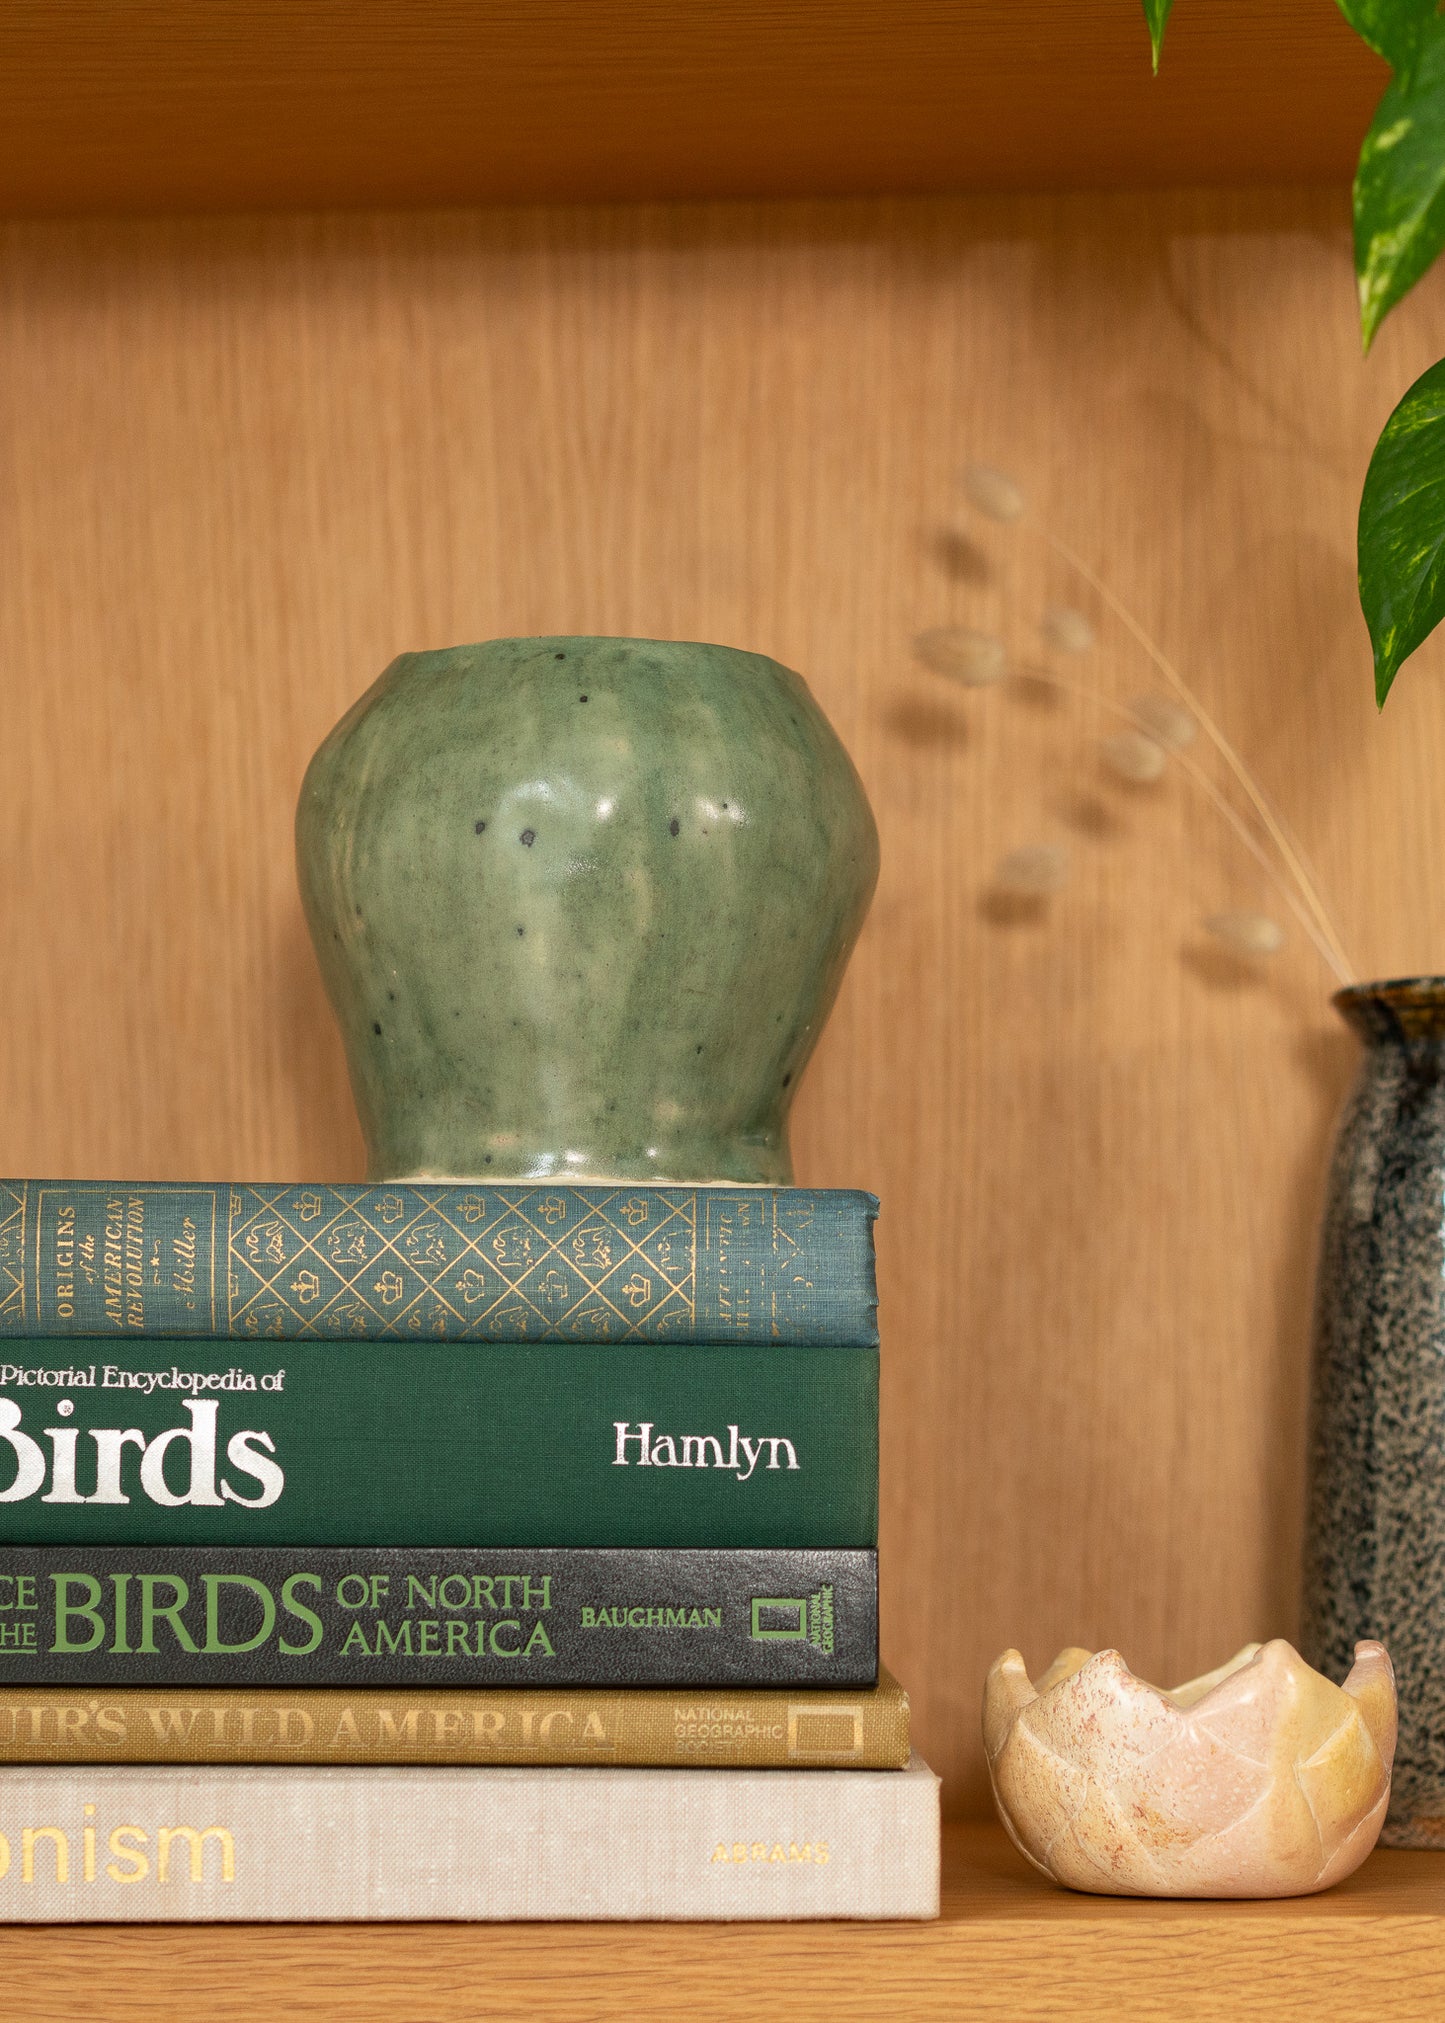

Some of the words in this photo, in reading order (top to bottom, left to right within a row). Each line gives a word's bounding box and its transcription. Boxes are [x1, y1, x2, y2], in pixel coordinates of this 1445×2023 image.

[57, 1206, 76, 1318] ORIGINS
[78, 1234, 96, 1261] the
[104, 1197, 124, 1328] AMERICAN
[125, 1196, 145, 1329] REVOLUTION
[0, 1364, 96, 1388] Pictorial
[101, 1365, 257, 1395] Encyclopedia
[260, 1369, 286, 1391] of
[0, 1398, 285, 1508] Birds
[612, 1422, 801, 1480] Hamlyn
[48, 1573, 324, 1656] BIRDS
[336, 1574, 390, 1610] OF
[406, 1574, 553, 1611] NORTH
[0, 1622, 38, 1647] HE
[339, 1620, 557, 1657] AMERICA
[581, 1606, 723, 1629] BAUGHMAN
[810, 1592, 821, 1646] NATIONAL
[821, 1583, 834, 1654] GEOGRAPHIC
[146, 1707, 315, 1748] WILD
[327, 1708, 616, 1751] AMERICA
[674, 1707, 755, 1722] NATIONAL
[674, 1724, 785, 1740] GEOGRAPHIC
[0, 1803, 236, 1884] nism
[710, 1841, 831, 1865] ABRAMS
